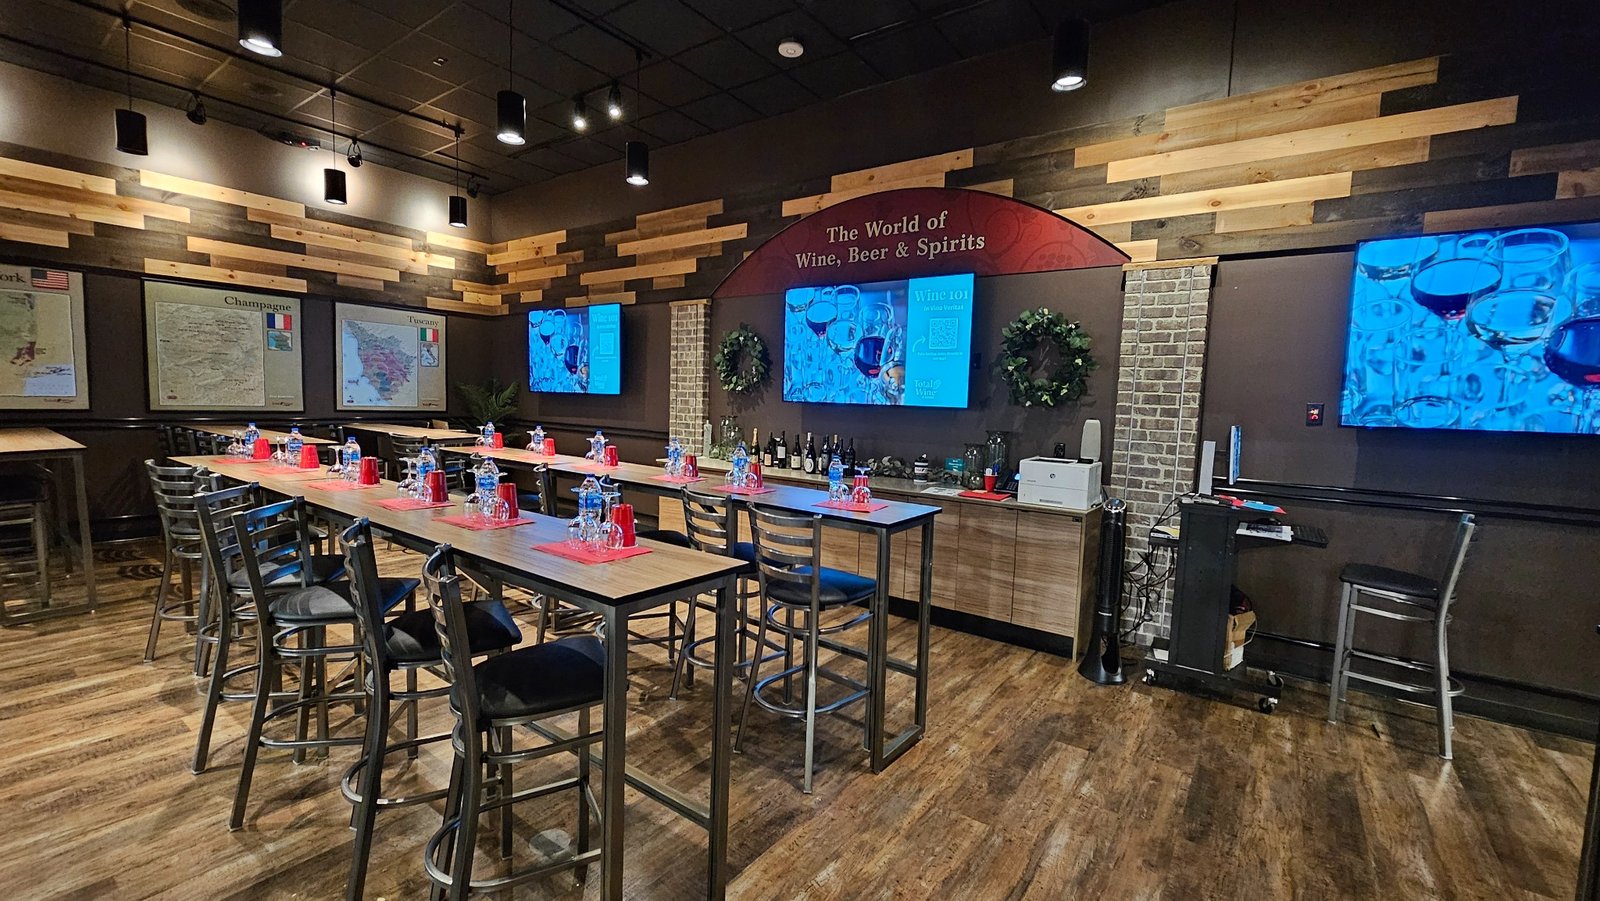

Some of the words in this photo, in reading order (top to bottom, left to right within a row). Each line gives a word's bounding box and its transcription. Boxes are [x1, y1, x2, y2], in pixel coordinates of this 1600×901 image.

[826, 226, 859, 243] The
[865, 214, 920, 238] World
[926, 210, 948, 230] of
[795, 252, 842, 269] Wine,
[848, 246, 889, 263] Beer
[895, 241, 910, 258] &
[916, 233, 986, 260] Spirits
[0, 271, 27, 284] ork
[914, 288, 946, 302] Wine
[949, 289, 969, 300] 101
[224, 295, 292, 312] Champagne
[407, 315, 440, 328] Tuscany
[914, 379, 933, 388] Total
[915, 388, 937, 396] Wine
